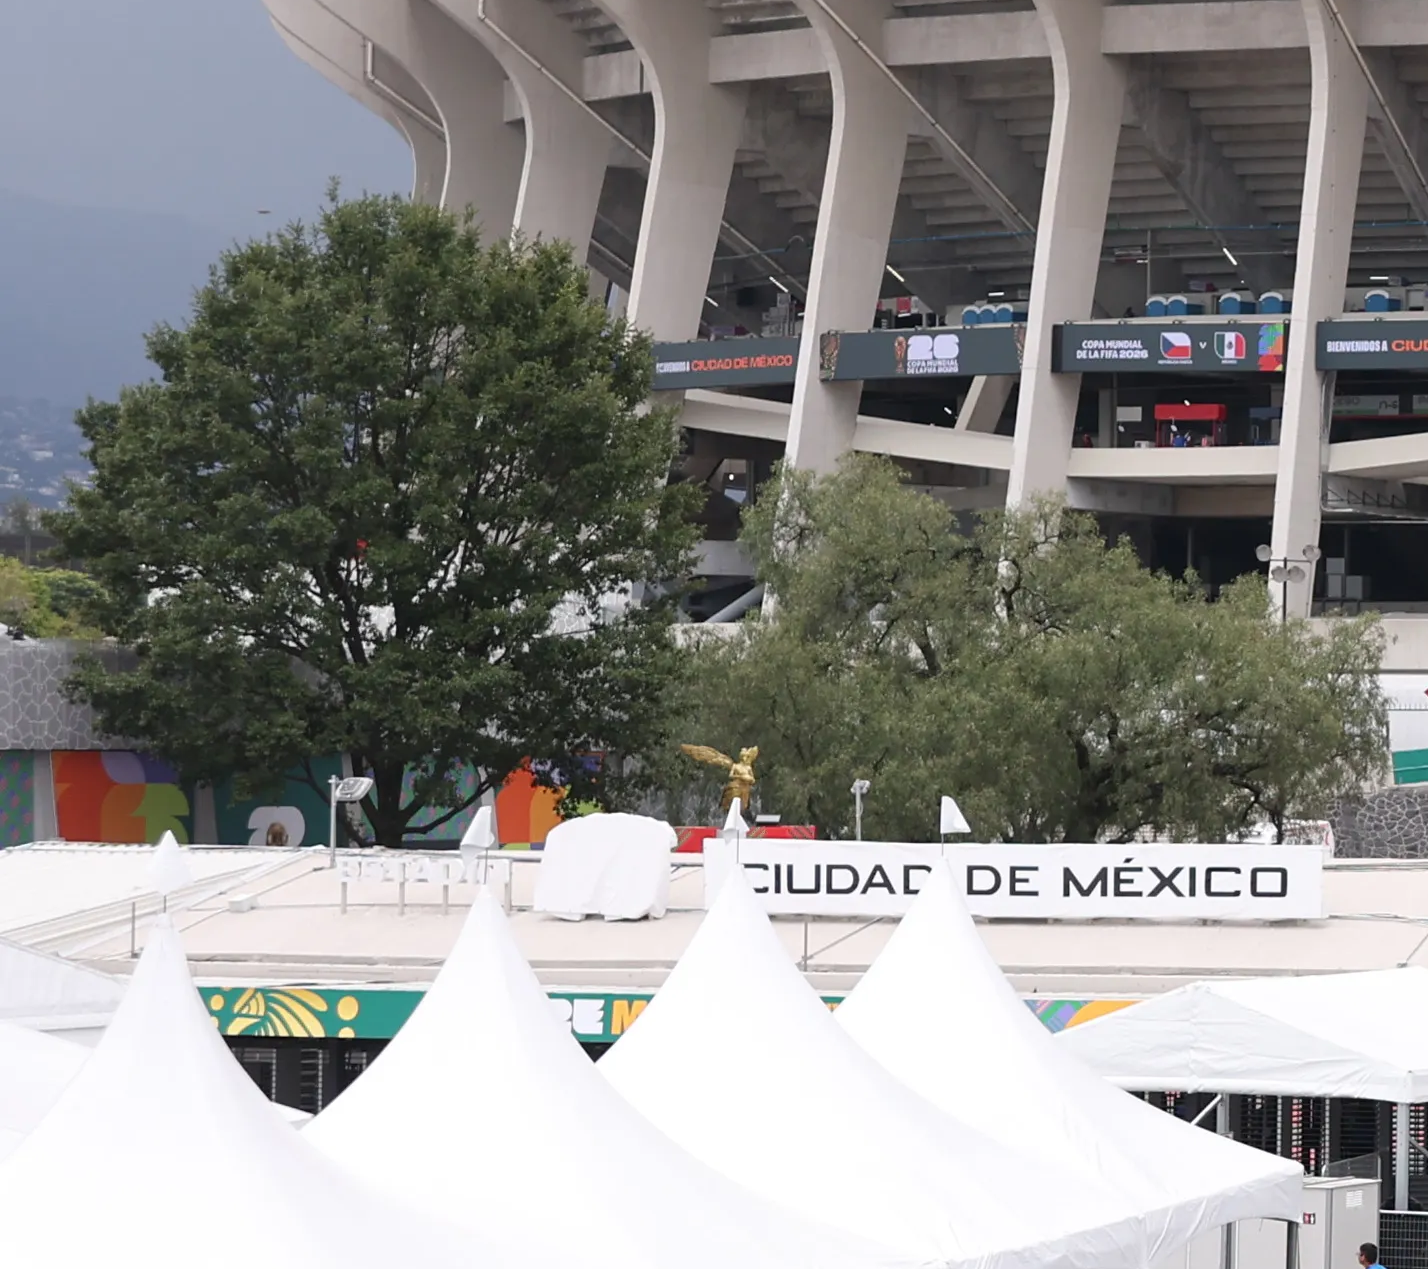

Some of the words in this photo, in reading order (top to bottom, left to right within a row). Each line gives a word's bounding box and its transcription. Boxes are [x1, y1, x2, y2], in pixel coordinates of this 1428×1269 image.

[1082, 340, 1104, 349] COPA
[1105, 340, 1142, 350] MUNDIAL
[1326, 340, 1381, 353] BIENVENIDOS
[1381, 340, 1388, 352] A
[1076, 349, 1088, 359] DE
[1088, 349, 1100, 359] LA
[1101, 349, 1117, 359] FIFA
[1119, 349, 1149, 359] 2026
[691, 357, 732, 371] CIUDAD
[733, 356, 749, 369] DE
[750, 353, 793, 368] MÉXICO
[966, 864, 1040, 897] DE
[1062, 857, 1288, 898] MÉXICO
